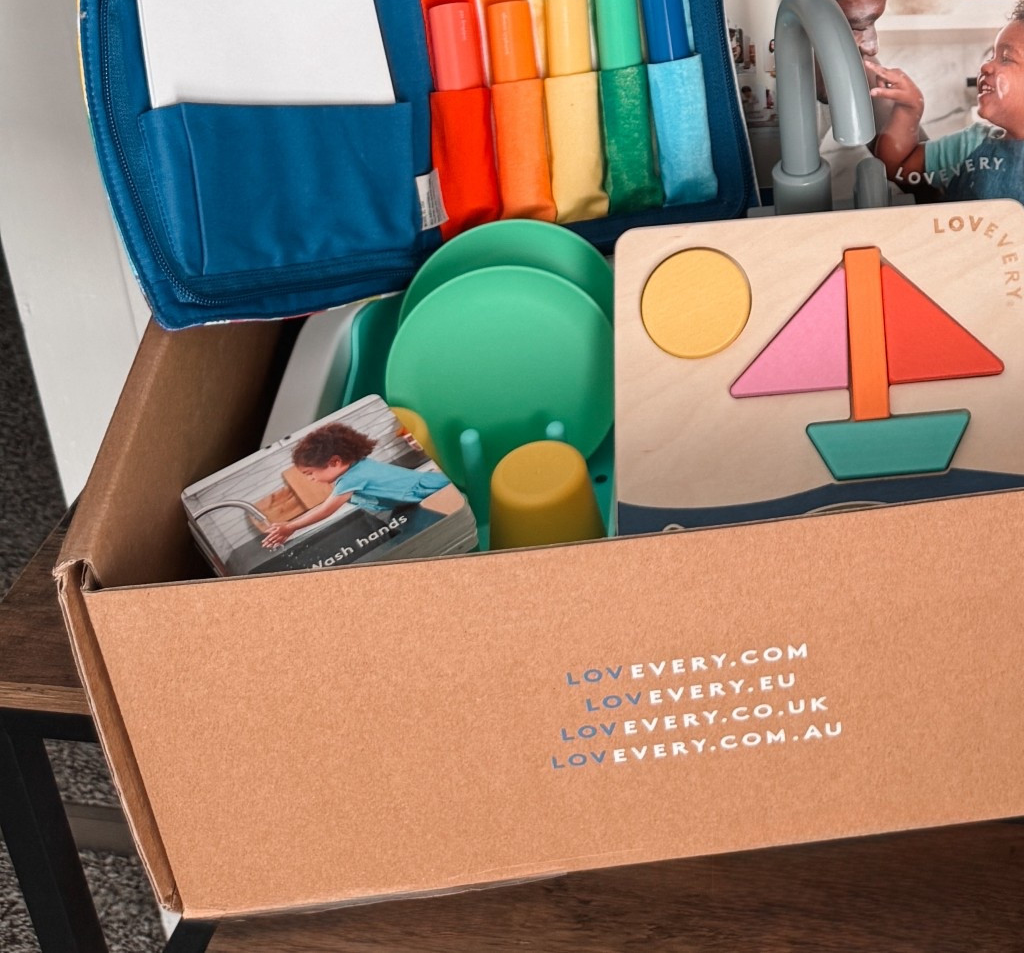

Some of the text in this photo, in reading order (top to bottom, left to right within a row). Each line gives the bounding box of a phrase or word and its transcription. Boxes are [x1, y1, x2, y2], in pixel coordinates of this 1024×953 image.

[356, 515, 408, 548] hands
[566, 643, 808, 686] LOVEVERY.COM
[585, 673, 796, 712] LOVEVERY.EU
[561, 696, 829, 741] LOVEVERY.CO.UK
[551, 722, 842, 769] LOVEVERY.COM.AU
